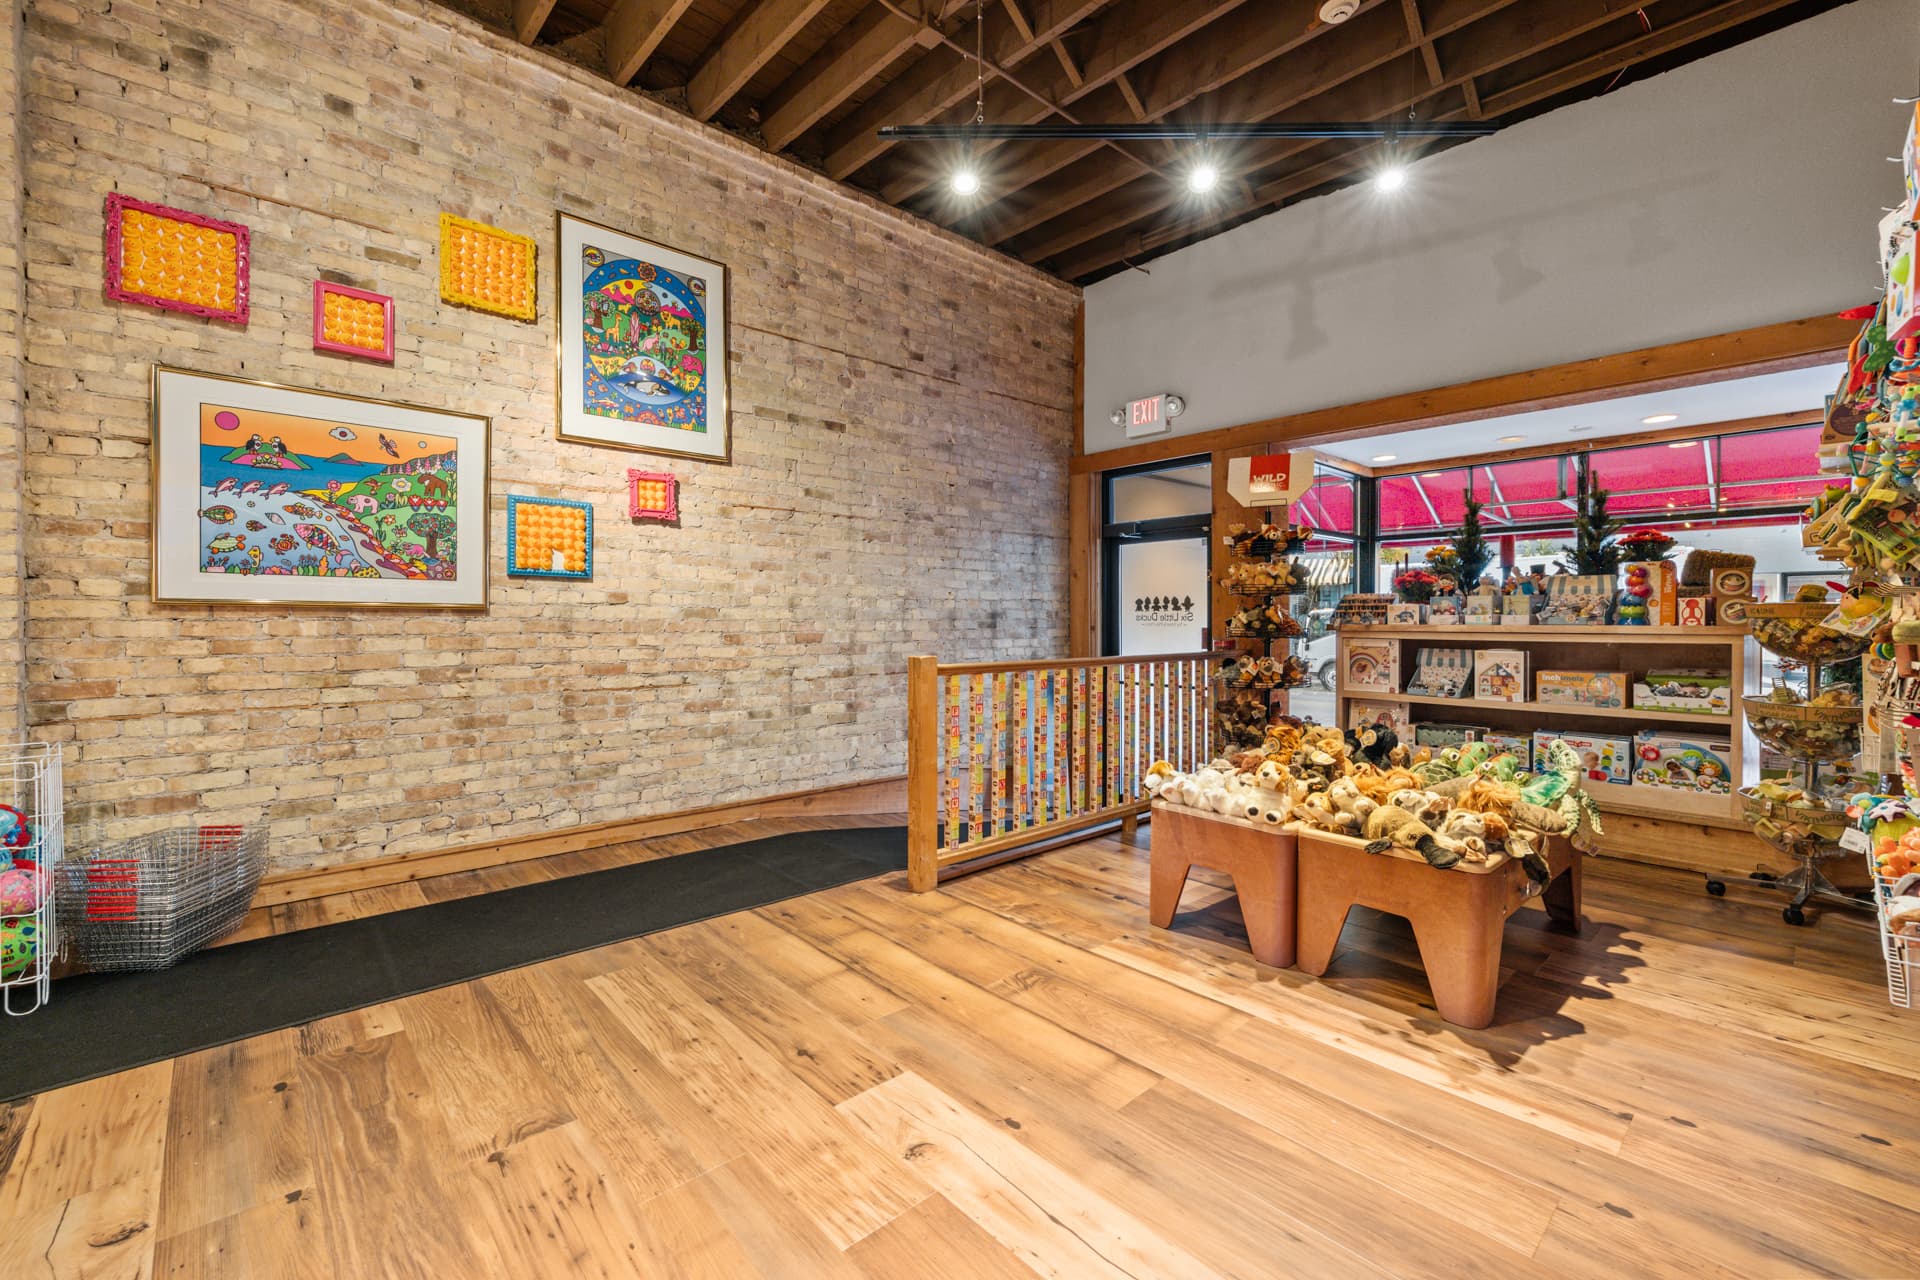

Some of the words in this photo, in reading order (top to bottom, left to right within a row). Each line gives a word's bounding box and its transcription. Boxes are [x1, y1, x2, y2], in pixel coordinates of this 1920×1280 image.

[1133, 397, 1160, 425] EXIT
[1252, 473, 1287, 483] WILD
[1814, 709, 1862, 722] VIKINGTO
[1795, 809, 1845, 822] VIKINGTO
